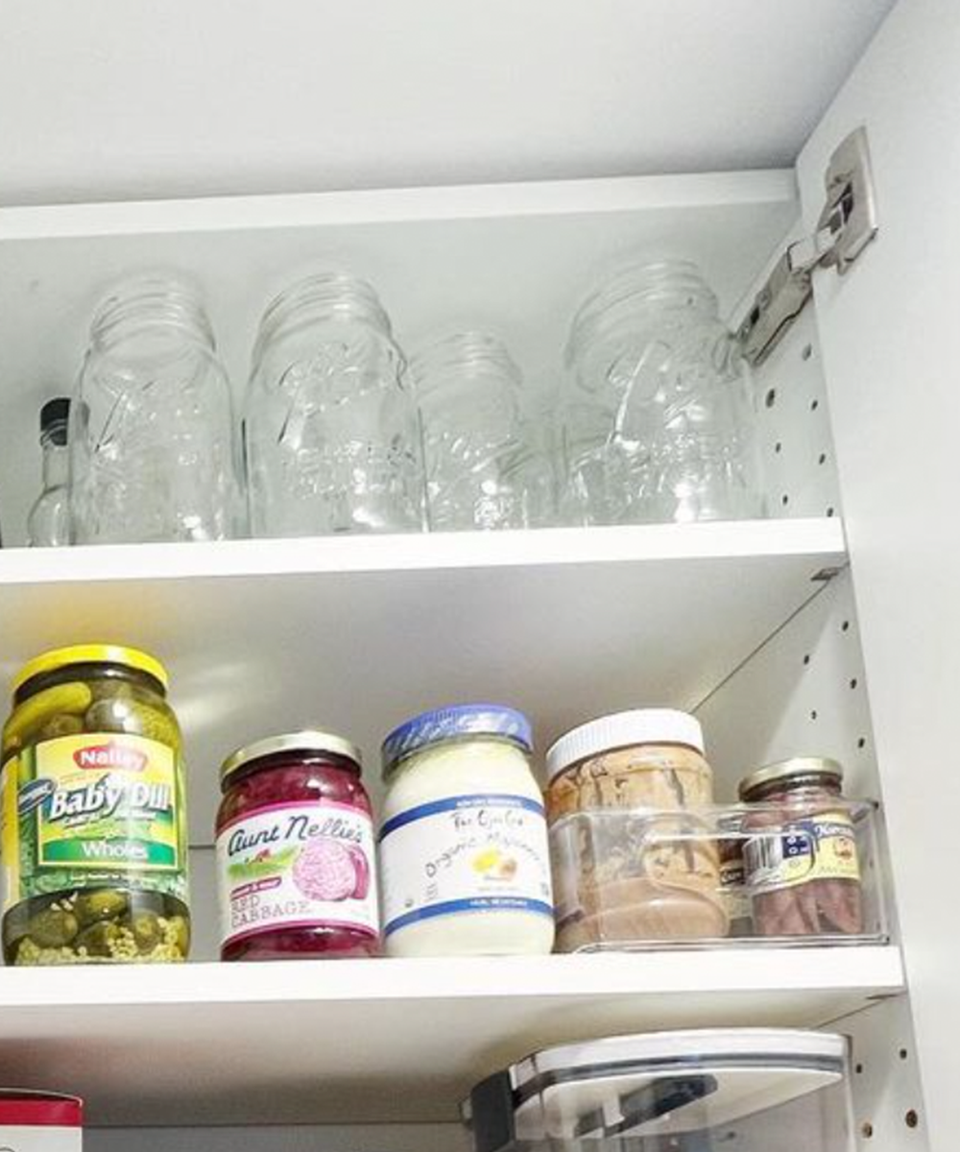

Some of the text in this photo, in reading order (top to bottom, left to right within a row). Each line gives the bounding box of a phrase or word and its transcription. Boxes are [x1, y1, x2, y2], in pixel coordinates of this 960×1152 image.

[50, 773, 170, 822] Baby Dill
[82, 840, 148, 859] Wholes
[228, 815, 363, 857] Aunt Nellie's
